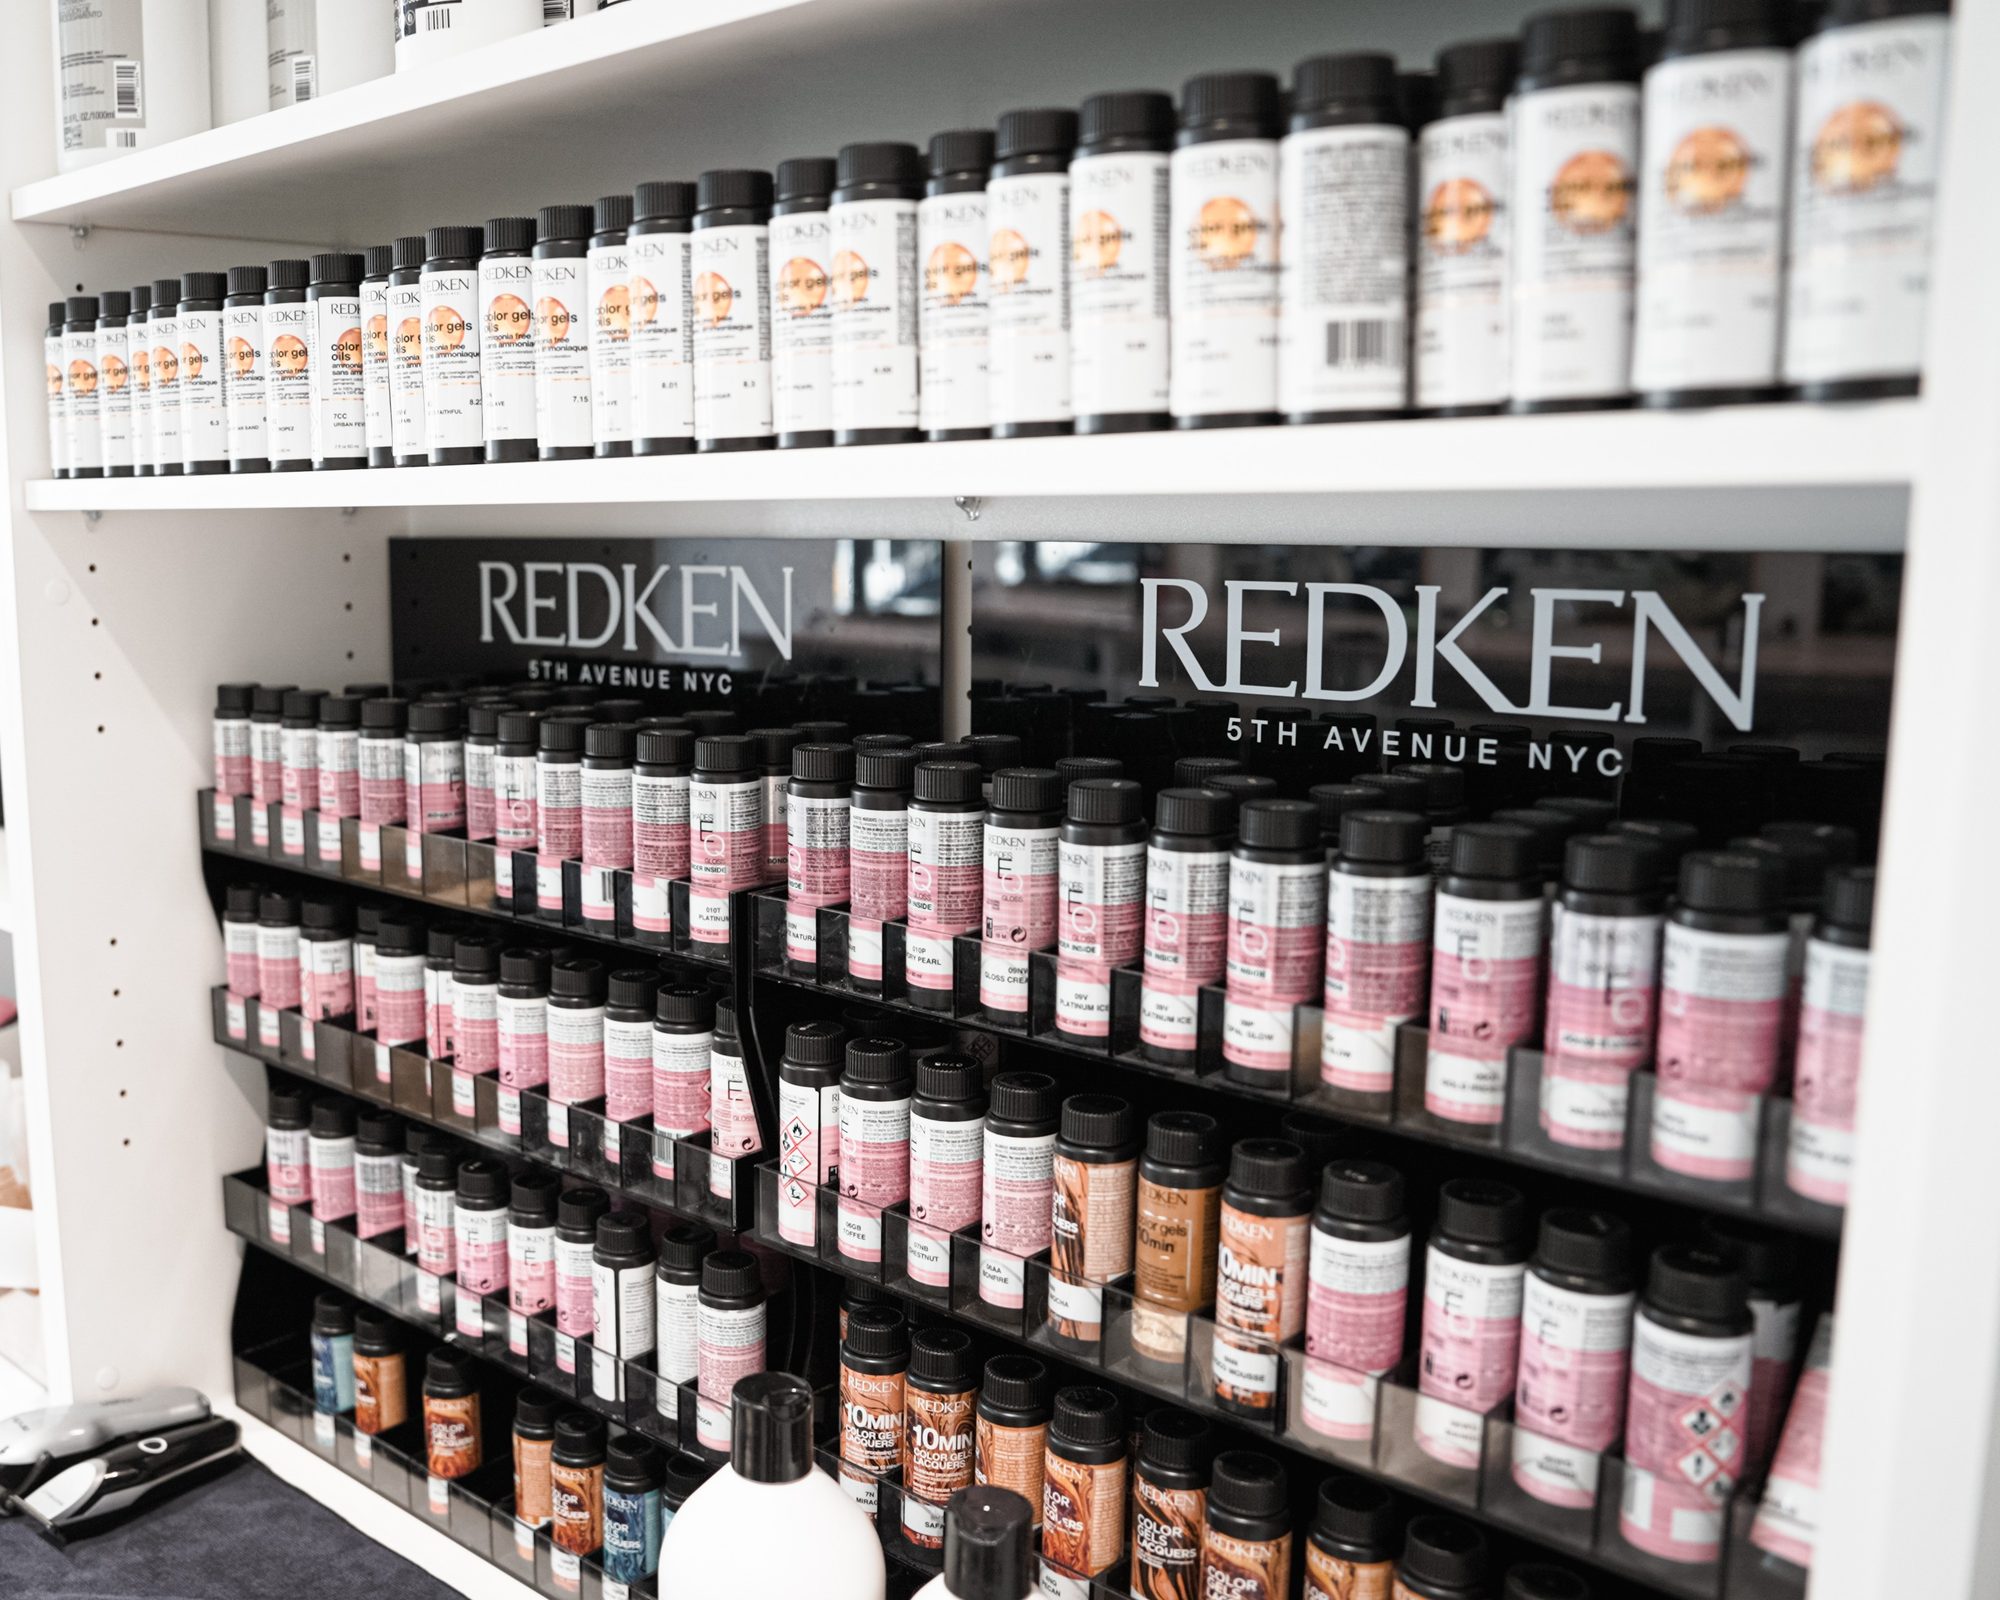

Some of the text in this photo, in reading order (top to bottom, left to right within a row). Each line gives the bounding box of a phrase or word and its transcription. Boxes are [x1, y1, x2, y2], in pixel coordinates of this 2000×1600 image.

[446, 320, 473, 334] gels
[331, 341, 360, 351] color
[331, 351, 351, 361] oils
[479, 561, 794, 661] REDKEN
[1138, 577, 1766, 732] REDKEN
[528, 660, 733, 695] 5TH AVENUE NYC
[1226, 717, 1625, 777] 5TH AVENUE NYC
[918, 956, 942, 966] PEARL
[847, 1375, 900, 1393] REDKEN
[844, 1401, 903, 1430] 10MIN
[917, 1397, 972, 1414] REDKEN
[845, 1424, 903, 1440] COLOR GELS
[845, 1434, 895, 1449] LACQUERS
[912, 1424, 973, 1452] 10MIN
[913, 1447, 973, 1462] COLOR GELS
[913, 1455, 966, 1470] LACQUERS
[1138, 1480, 1196, 1506] REDKEN
[1137, 1513, 1184, 1539] COLOR
[1137, 1523, 1168, 1547] GELS
[1137, 1533, 1197, 1559] LACQUERS
[1207, 1564, 1258, 1592] COLOR
